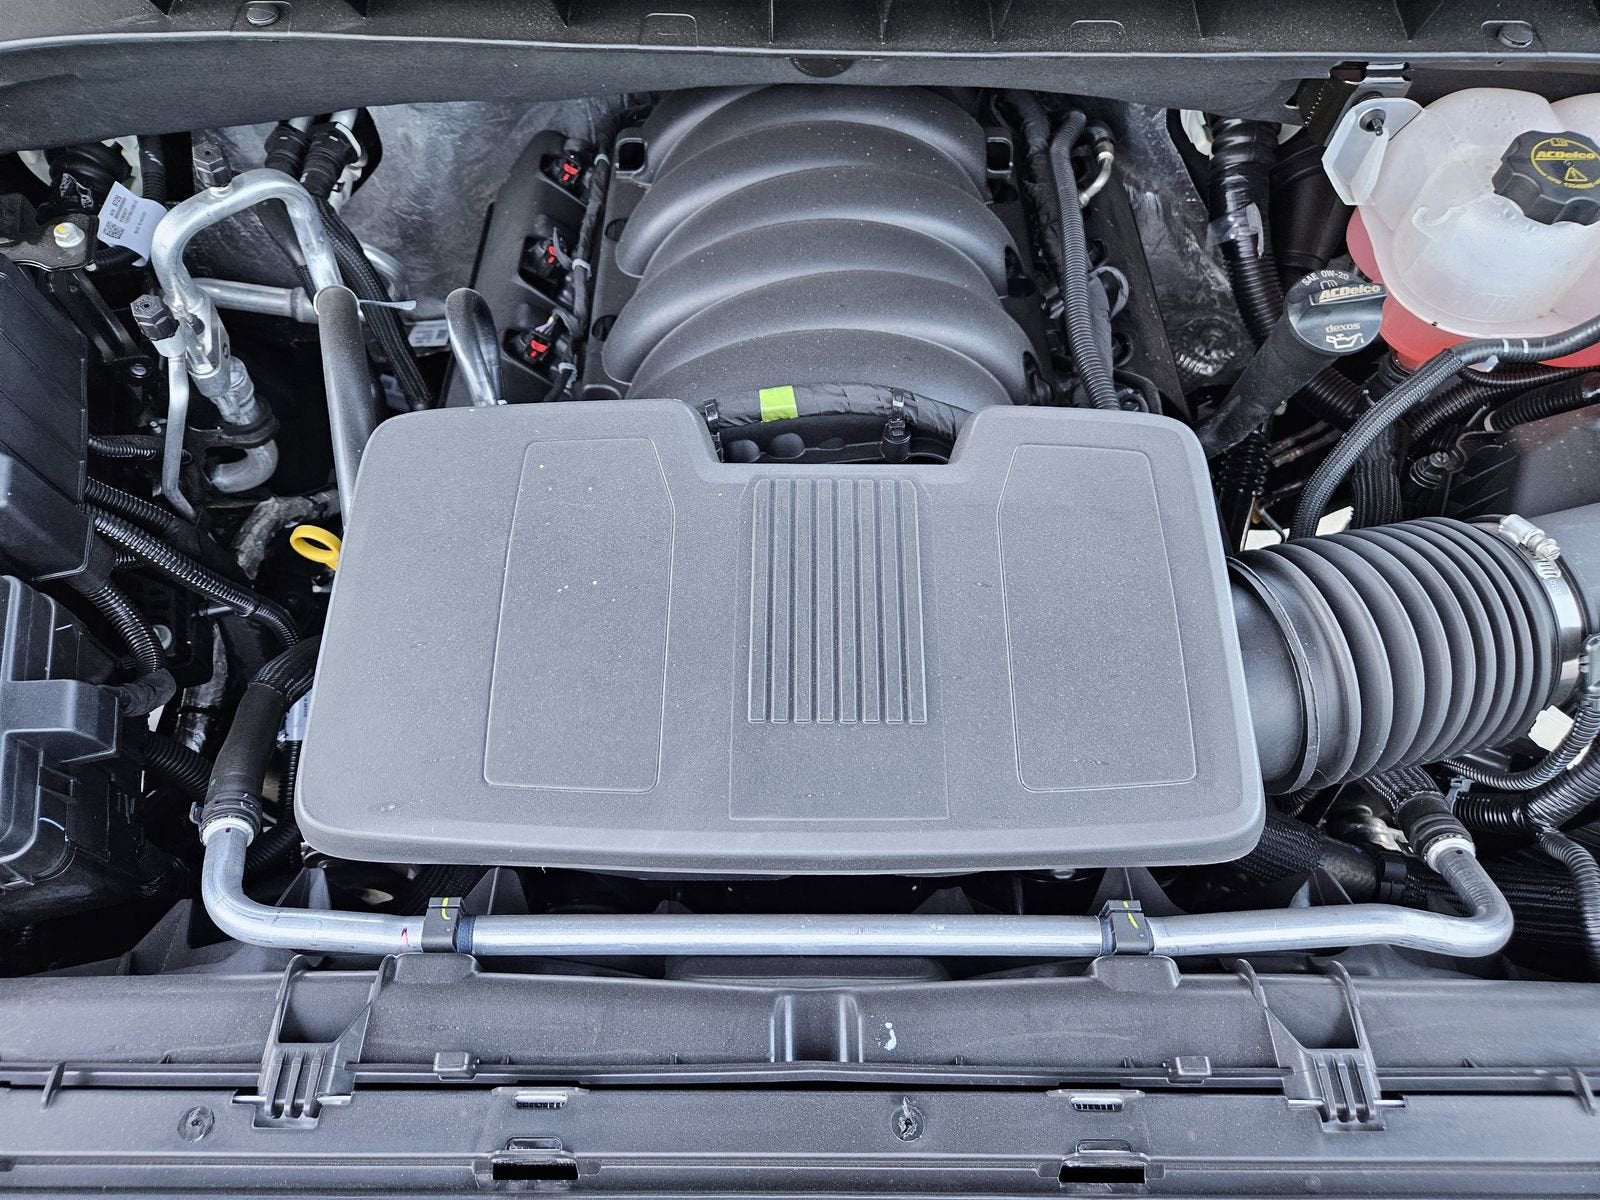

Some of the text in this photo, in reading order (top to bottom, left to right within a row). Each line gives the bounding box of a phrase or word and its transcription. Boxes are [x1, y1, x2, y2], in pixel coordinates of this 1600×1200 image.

[1535, 150, 1596, 159] ACDelco
[1301, 269, 1349, 286] SAE 0W-20
[1318, 284, 1381, 301] ACDelco
[1325, 322, 1361, 333] dexos
